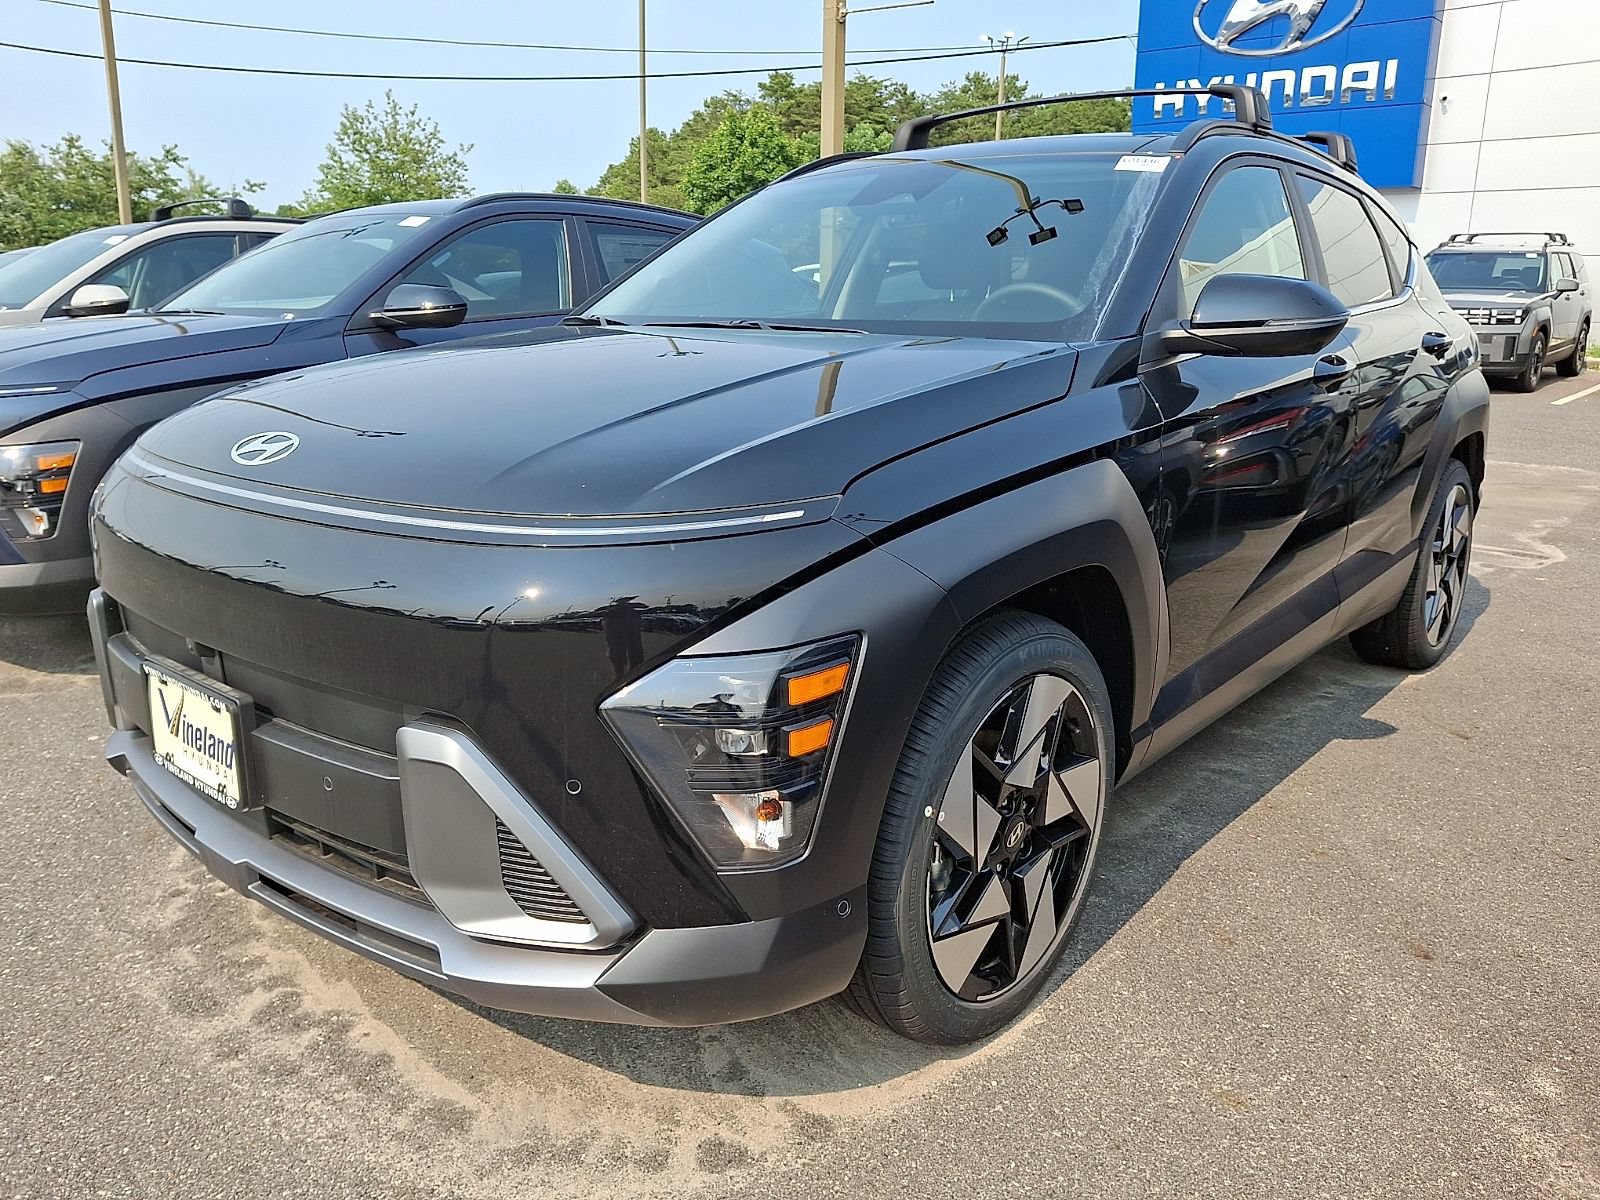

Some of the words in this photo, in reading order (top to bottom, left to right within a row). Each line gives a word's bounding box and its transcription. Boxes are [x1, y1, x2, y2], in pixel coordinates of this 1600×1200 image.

[1153, 58, 1399, 119] HYUNDAI
[158, 682, 236, 770] Vineland
[163, 758, 195, 785] VINELAND
[194, 777, 226, 805] HYUNDAI
